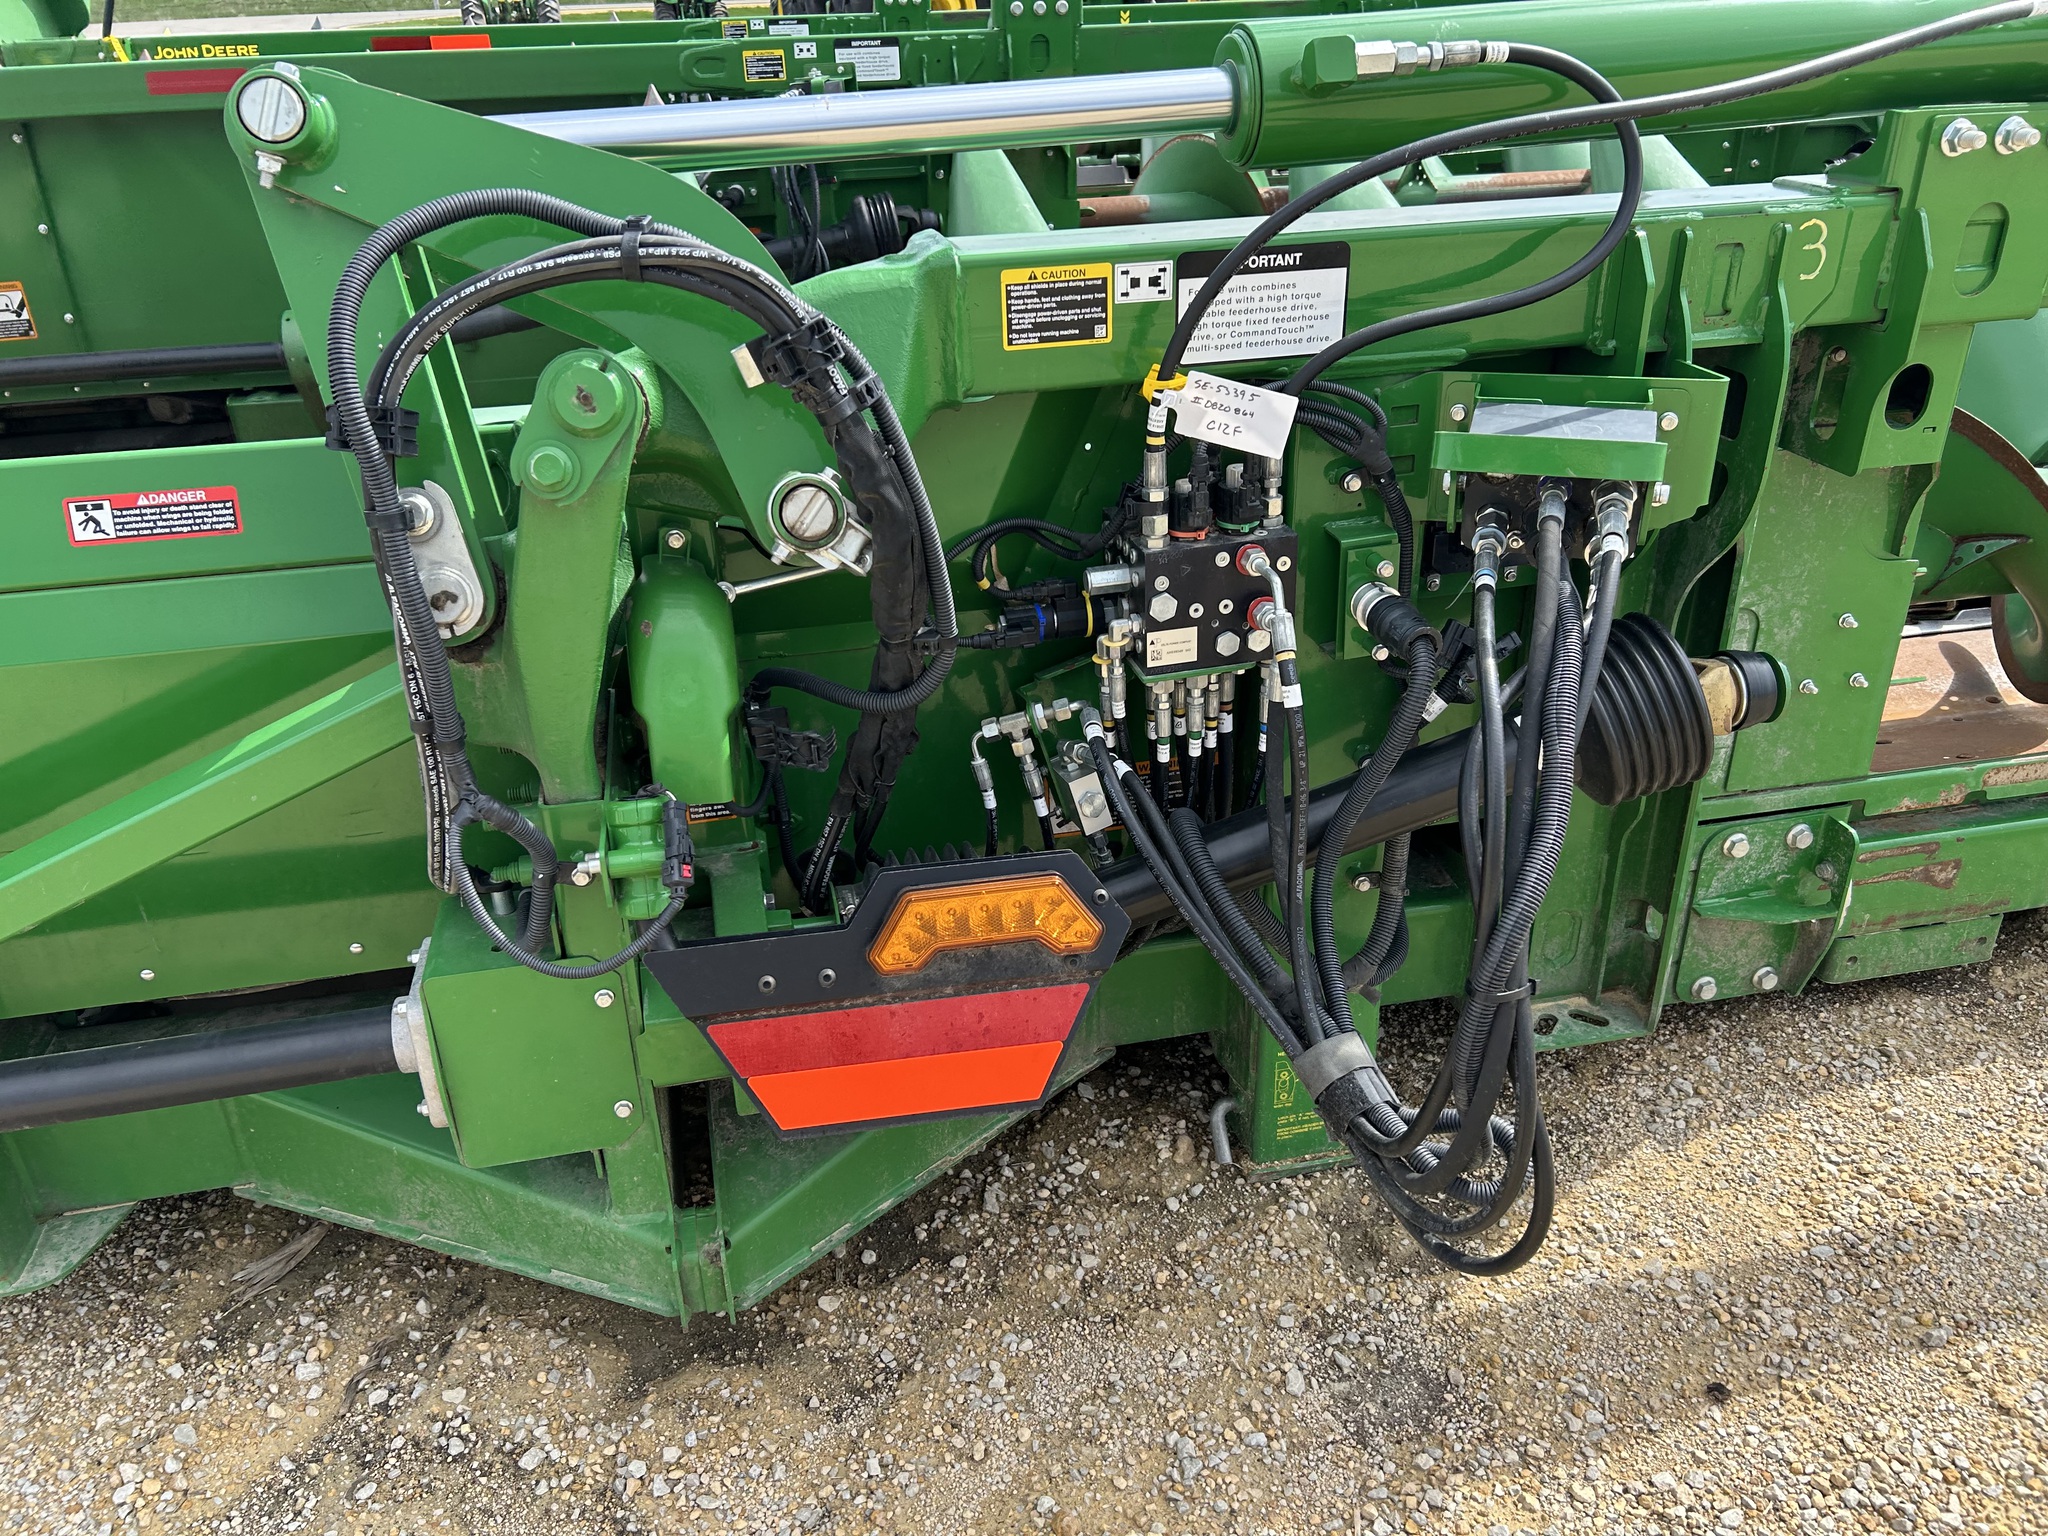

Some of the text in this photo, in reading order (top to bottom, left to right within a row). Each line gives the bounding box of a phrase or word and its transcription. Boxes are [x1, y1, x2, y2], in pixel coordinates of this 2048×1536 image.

[154, 44, 259, 60] JOHN DEERE
[648, 246, 670, 256] MPa
[671, 248, 692, 256] 22.5
[692, 248, 708, 258] WP
[1800, 218, 1828, 280] 3
[534, 258, 556, 270] SAE
[556, 252, 595, 265] exceeds
[516, 264, 534, 275] 100
[1041, 269, 1086, 280] CAUTION
[498, 272, 516, 282] R17
[476, 278, 490, 290] EN
[1228, 285, 1248, 293] with
[1251, 282, 1297, 292] combines
[460, 287, 476, 298] 857
[1236, 296, 1255, 304] with
[1267, 294, 1288, 304] high
[1291, 291, 1322, 301] torque
[442, 294, 460, 308] 1SC
[428, 306, 442, 319] DN
[1229, 303, 1317, 317] feederhouse drive,
[1211, 313, 1330, 330] torque fixed feederhouse
[423, 331, 442, 351] AT3K
[1187, 335, 1333, 353] multi-speed feederhouse drive.
[1206, 420, 1242, 436] C12F
[149, 490, 206, 504] DANGER
[141, 507, 160, 516] injury
[162, 513, 181, 521] wings
[194, 510, 212, 518] being
[124, 521, 156, 529] unfolded.
[171, 525, 192, 533] wings
[212, 522, 236, 530] rapidly.
[1287, 662, 1296, 684] ceeds
[408, 680, 418, 694] DN
[412, 693, 422, 710] 1SC
[1294, 713, 1304, 732] (3000
[424, 738, 432, 752] R17
[432, 785, 441, 812] exceeds
[1296, 860, 1304, 900] ALFAGOMMA
[1238, 984, 1248, 996] R17
